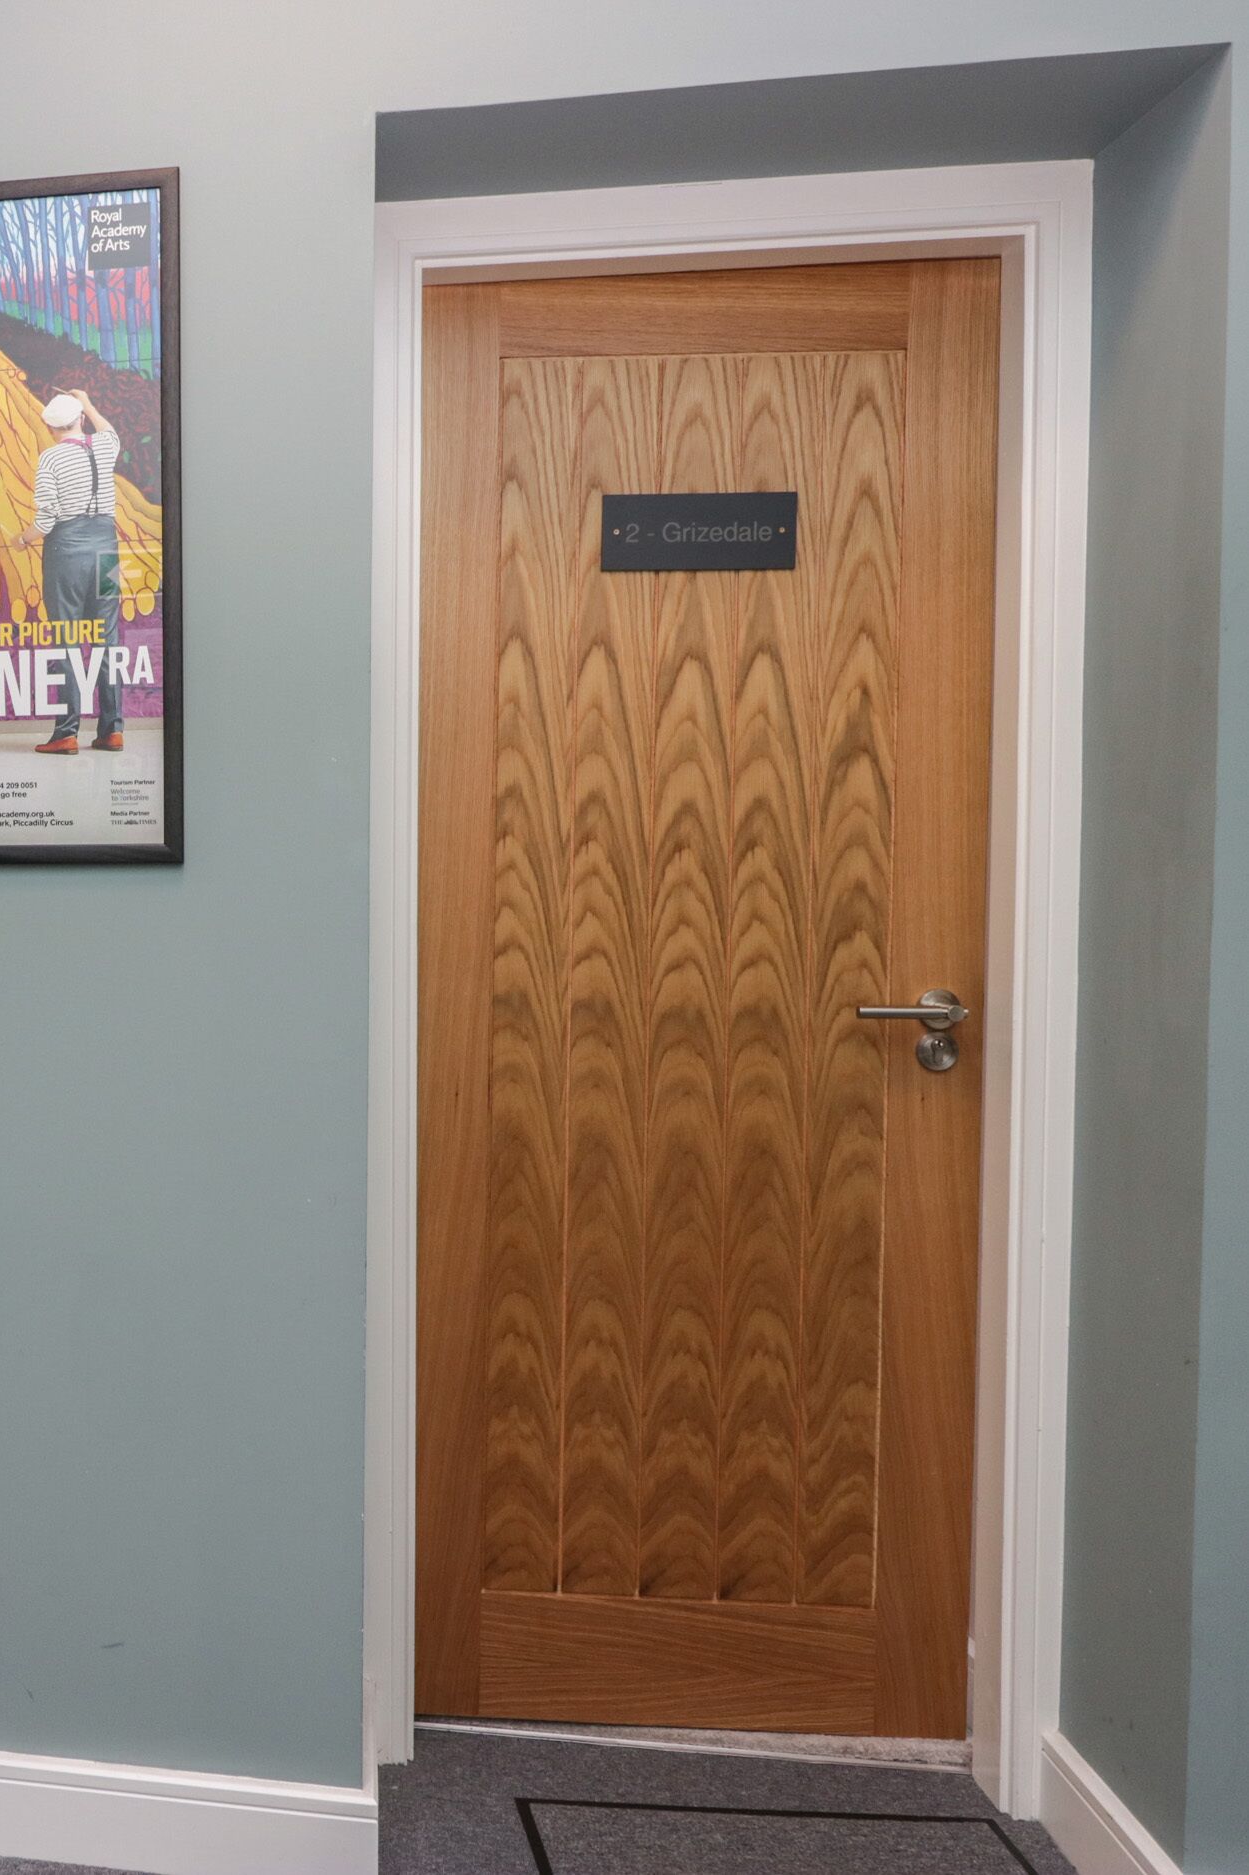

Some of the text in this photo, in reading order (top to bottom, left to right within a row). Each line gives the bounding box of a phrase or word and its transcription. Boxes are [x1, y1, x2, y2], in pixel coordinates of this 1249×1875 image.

[91, 208, 122, 225] Royal
[91, 224, 147, 238] Academy
[91, 238, 130, 253] of Arts
[625, 523, 640, 543] 2
[662, 522, 773, 543] Grizedale
[19, 618, 106, 645] PICTURE
[108, 645, 155, 686] RA
[13, 819, 48, 828] Piccadilly
